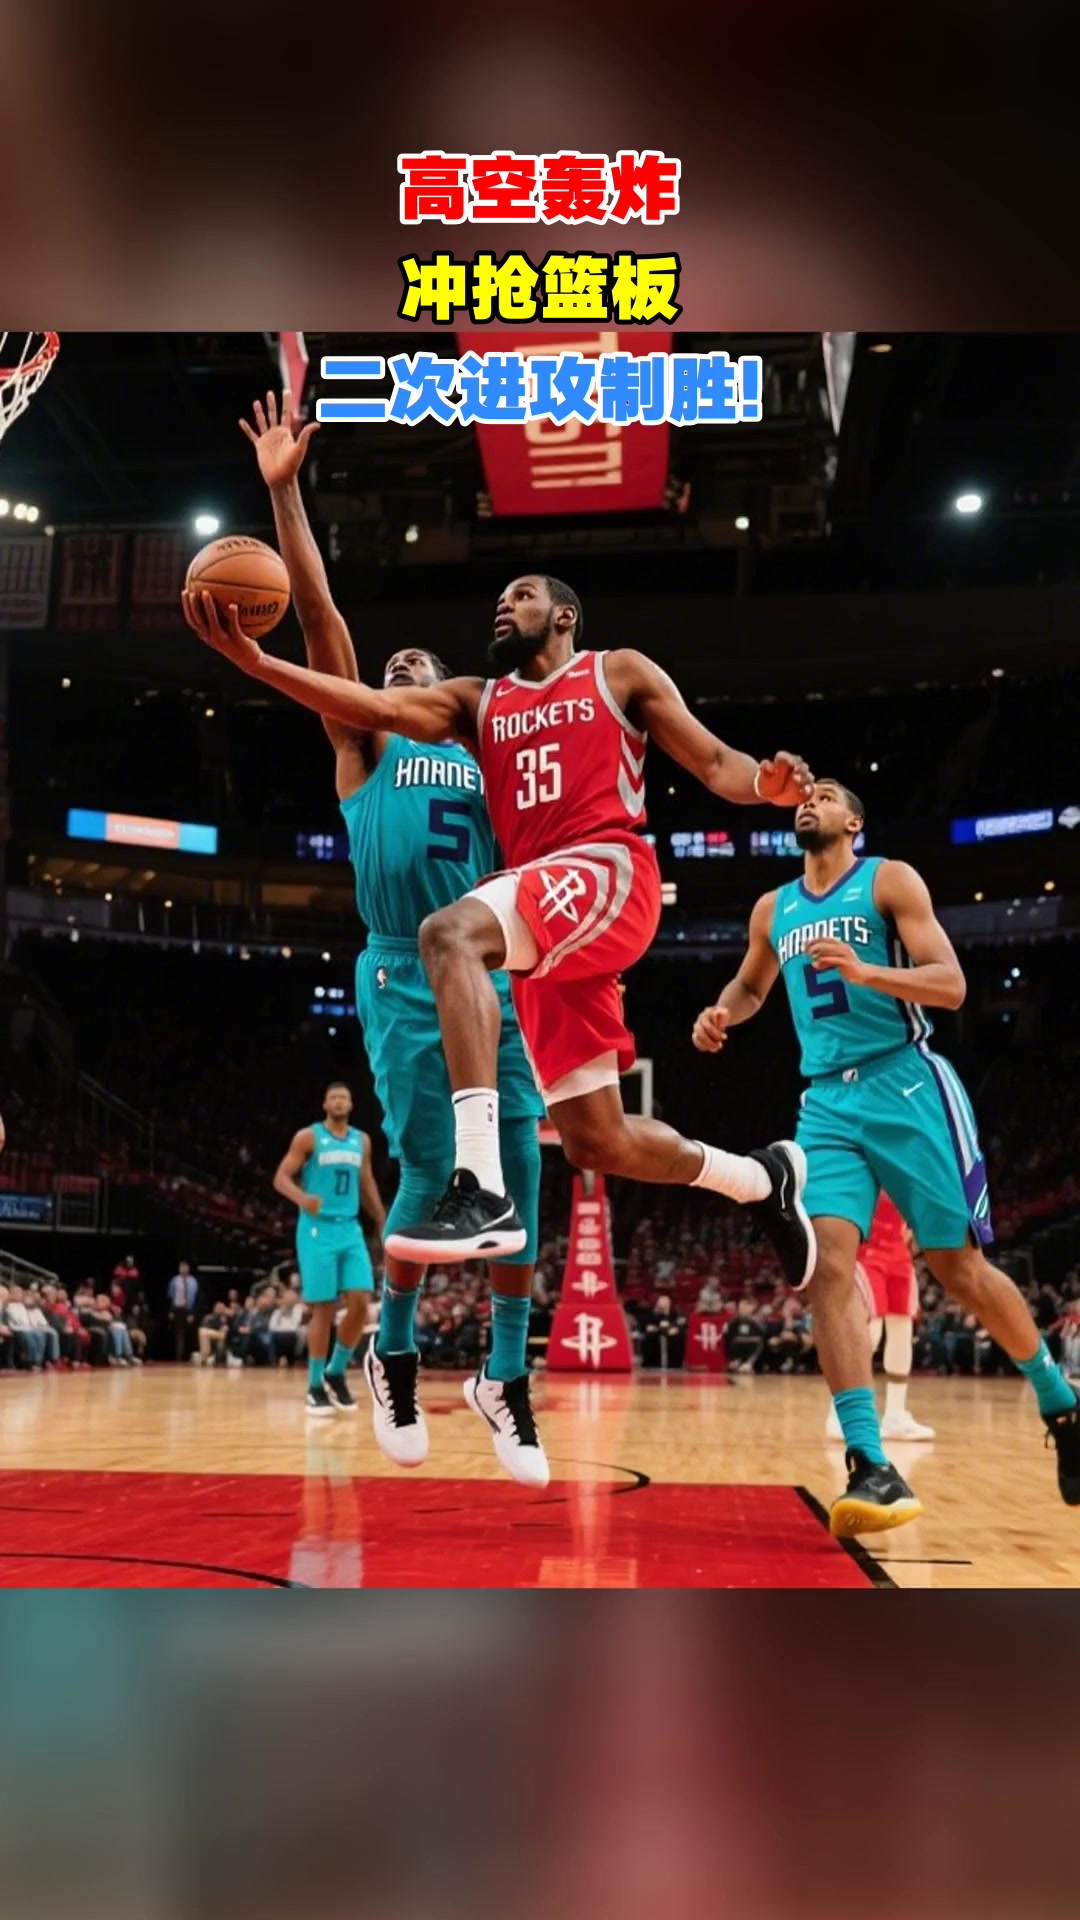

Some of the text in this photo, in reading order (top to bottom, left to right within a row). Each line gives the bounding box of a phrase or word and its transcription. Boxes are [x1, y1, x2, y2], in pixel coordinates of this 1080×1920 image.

[491, 697, 596, 744] ROCKETS
[515, 742, 563, 811] 35
[426, 797, 471, 864] 5
[802, 961, 850, 1020] 5
